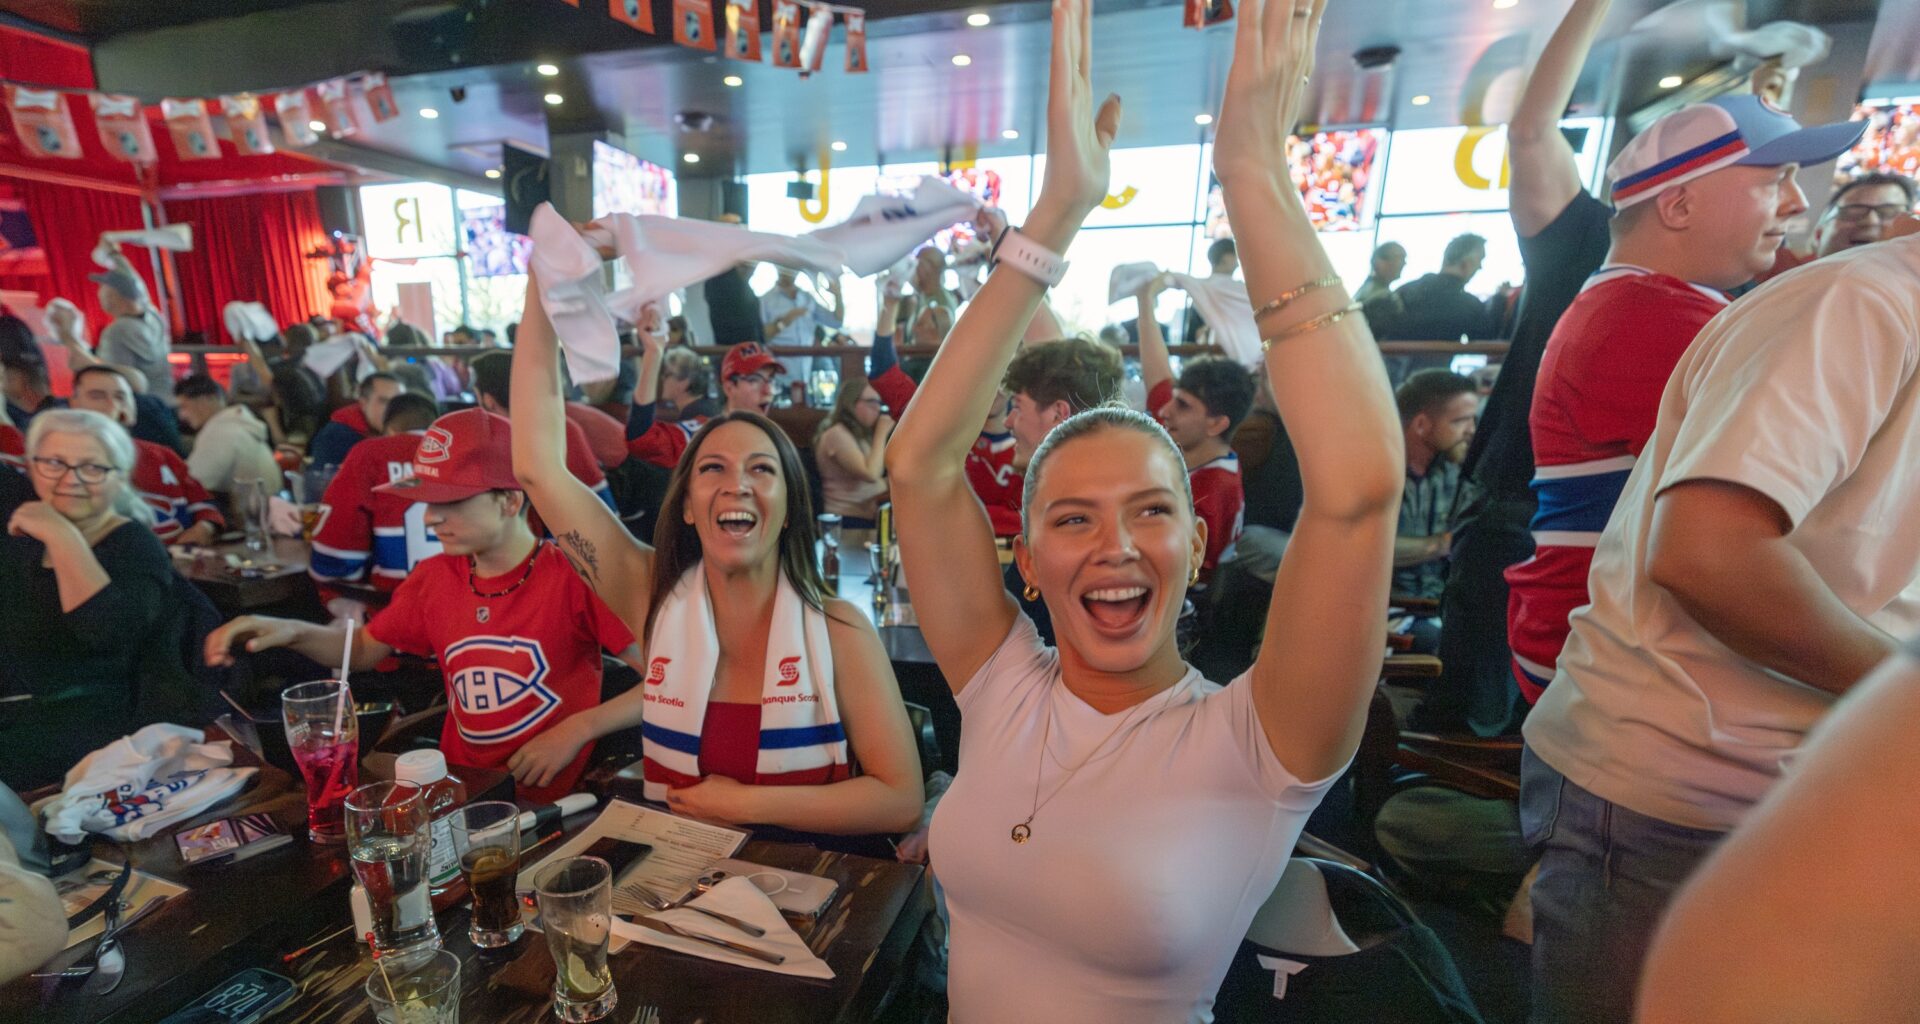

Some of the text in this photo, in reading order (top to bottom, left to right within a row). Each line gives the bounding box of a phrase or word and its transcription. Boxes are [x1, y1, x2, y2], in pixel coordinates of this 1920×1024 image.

[996, 464, 1014, 487] C
[658, 694, 684, 708] Scotia
[203, 982, 269, 1018] 8:24
